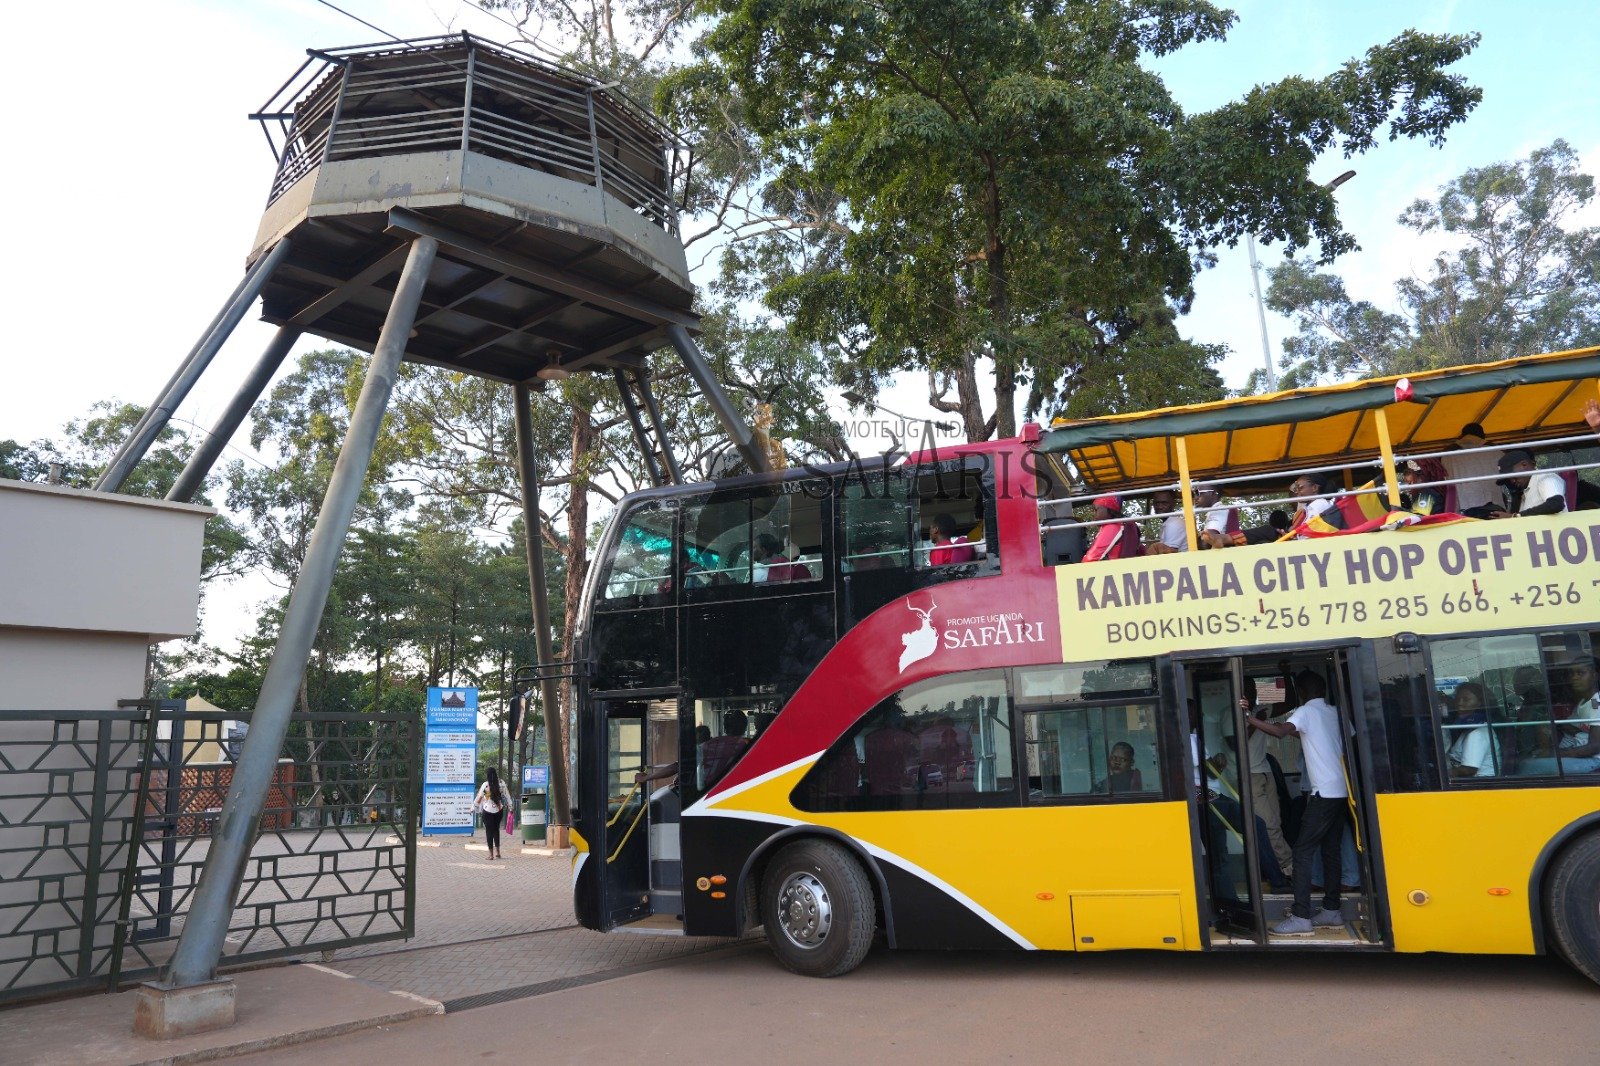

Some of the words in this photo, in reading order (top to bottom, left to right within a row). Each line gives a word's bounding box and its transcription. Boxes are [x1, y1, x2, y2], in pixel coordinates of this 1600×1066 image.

[1077, 562, 1243, 611] KAMPALA
[1254, 552, 1331, 594] CITY
[1344, 544, 1425, 585] HOP
[1438, 534, 1513, 576] OFF
[946, 615, 986, 627] PROMOTE
[986, 612, 1024, 624] UGANDA
[1320, 601, 1368, 625] 778
[1379, 595, 1428, 620] 285
[1441, 590, 1499, 615] 666,
[1510, 582, 1581, 608] +256
[943, 614, 1046, 650] SAFARI
